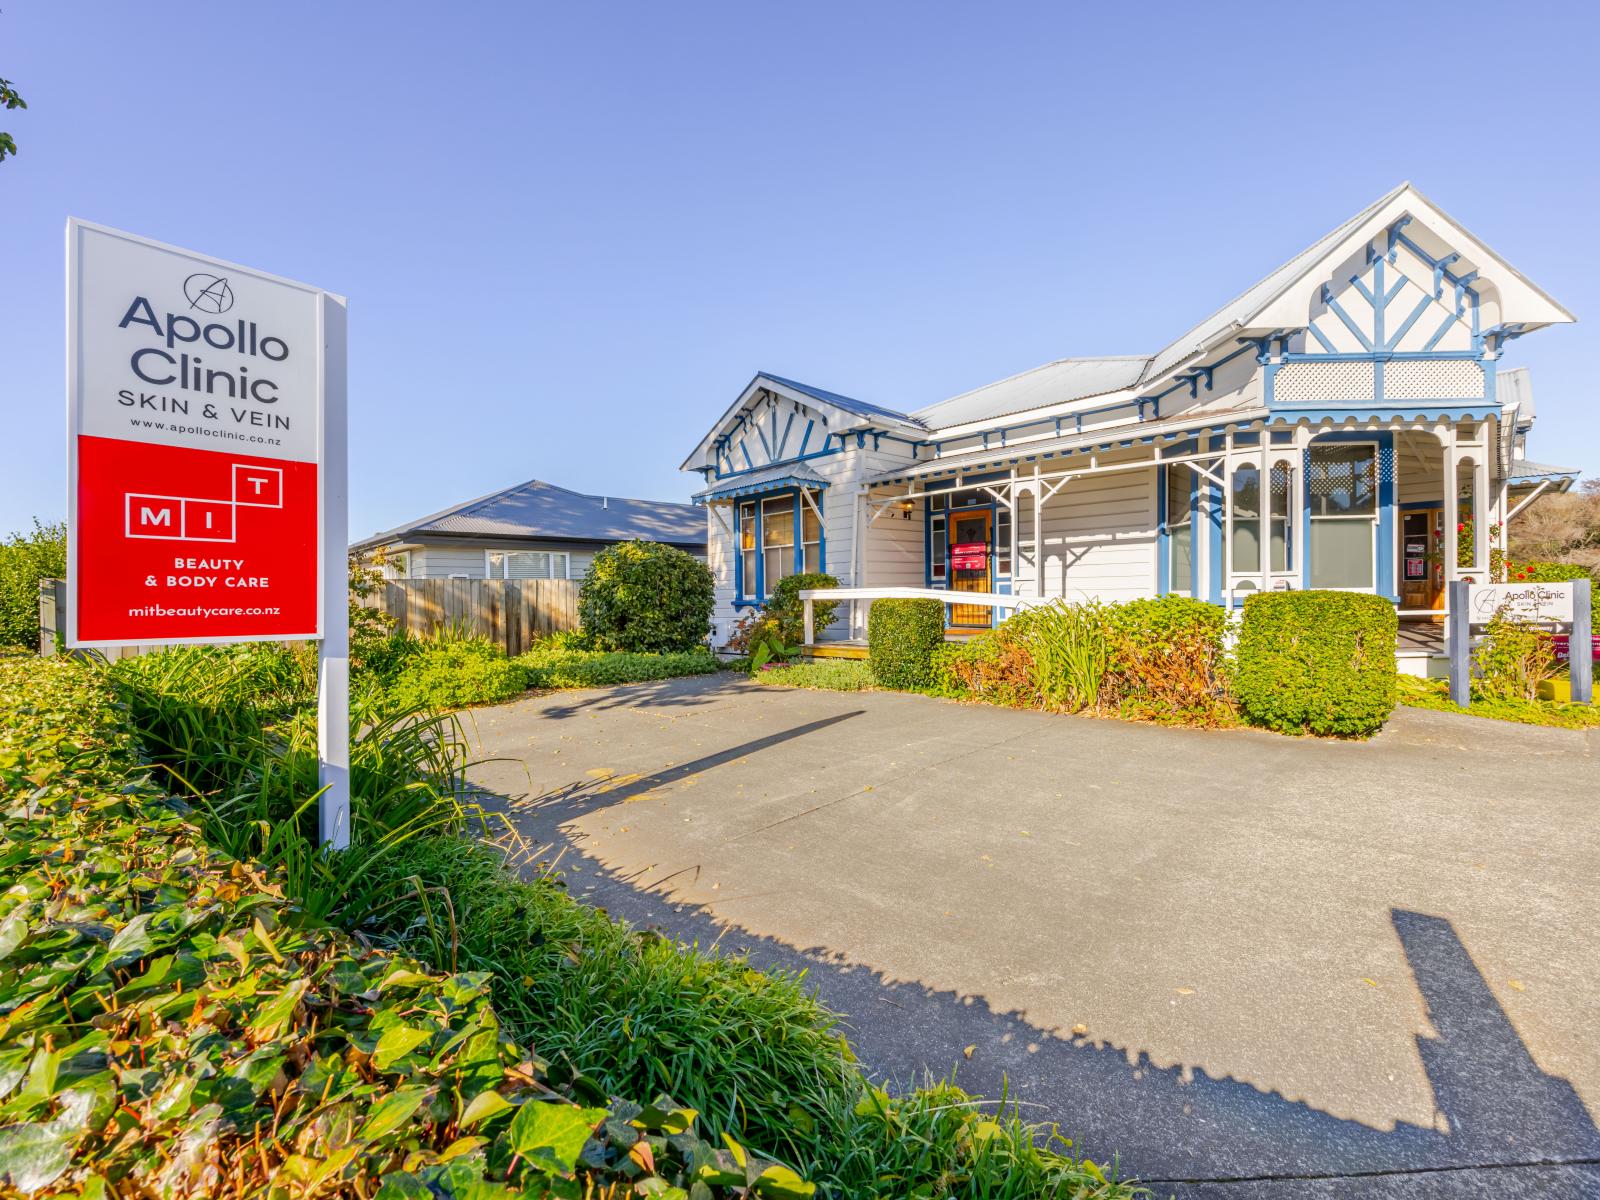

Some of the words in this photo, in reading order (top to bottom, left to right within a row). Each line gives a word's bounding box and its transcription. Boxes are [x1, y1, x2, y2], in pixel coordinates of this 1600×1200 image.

[118, 295, 290, 361] Apollo
[130, 347, 279, 404] Clinic
[117, 389, 189, 415] SKIN
[202, 403, 219, 420] &
[230, 407, 290, 431] VEIN
[130, 418, 282, 446] www.apolloclinic.co.nz
[174, 557, 244, 570] BEAUTY
[144, 575, 158, 587] &
[166, 575, 217, 588] BODY
[224, 576, 269, 588] CARE
[1504, 589, 1536, 601] Apollo
[1537, 589, 1566, 600] Clinic
[128, 603, 281, 619] mitbeautycare.co.nz
